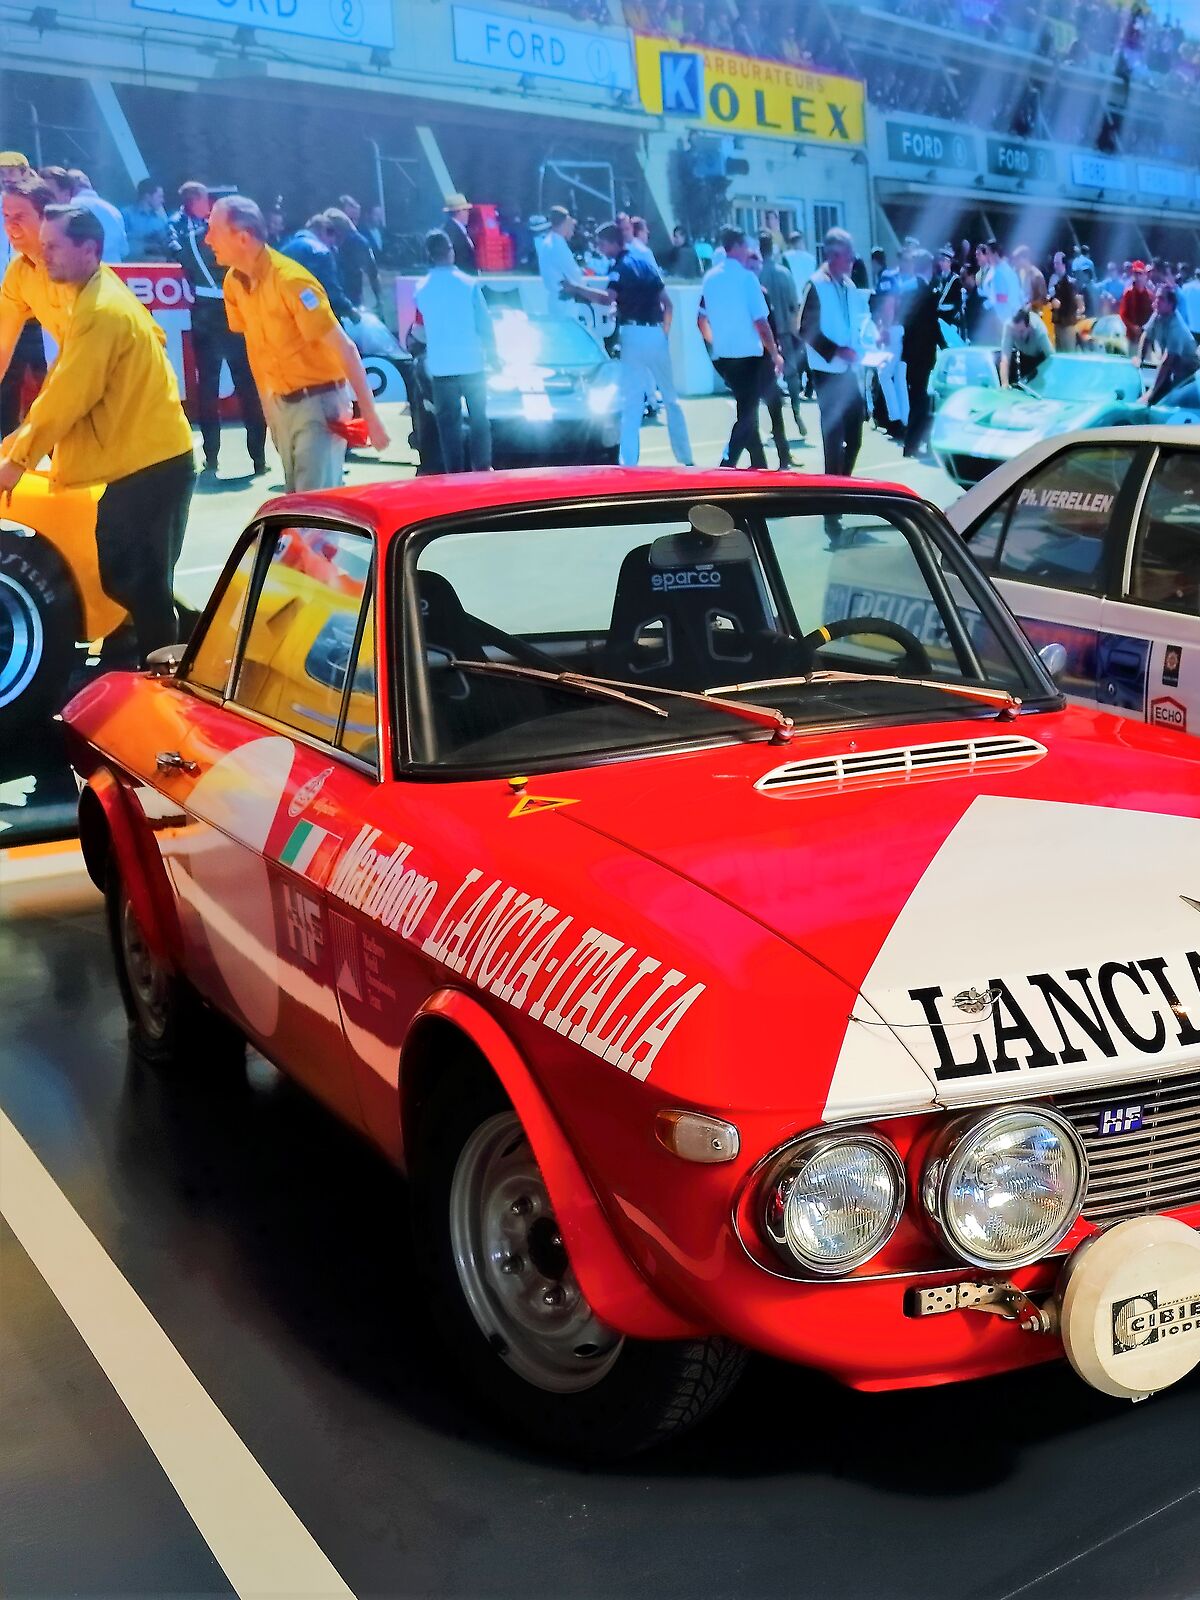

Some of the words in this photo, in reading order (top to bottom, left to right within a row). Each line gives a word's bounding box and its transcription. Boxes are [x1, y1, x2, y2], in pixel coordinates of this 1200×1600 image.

[486, 24, 566, 66] FORD
[703, 56, 825, 94] ARBURATEURS
[902, 131, 944, 160] FORD
[999, 147, 1030, 173] FORD
[1039, 489, 1115, 513] VERELLEN
[651, 571, 721, 592] sparco
[861, 590, 982, 650] PEUGET
[1155, 706, 1182, 724] ECHO
[325, 823, 438, 940] Marlboro
[1103, 1105, 1141, 1134] HF
